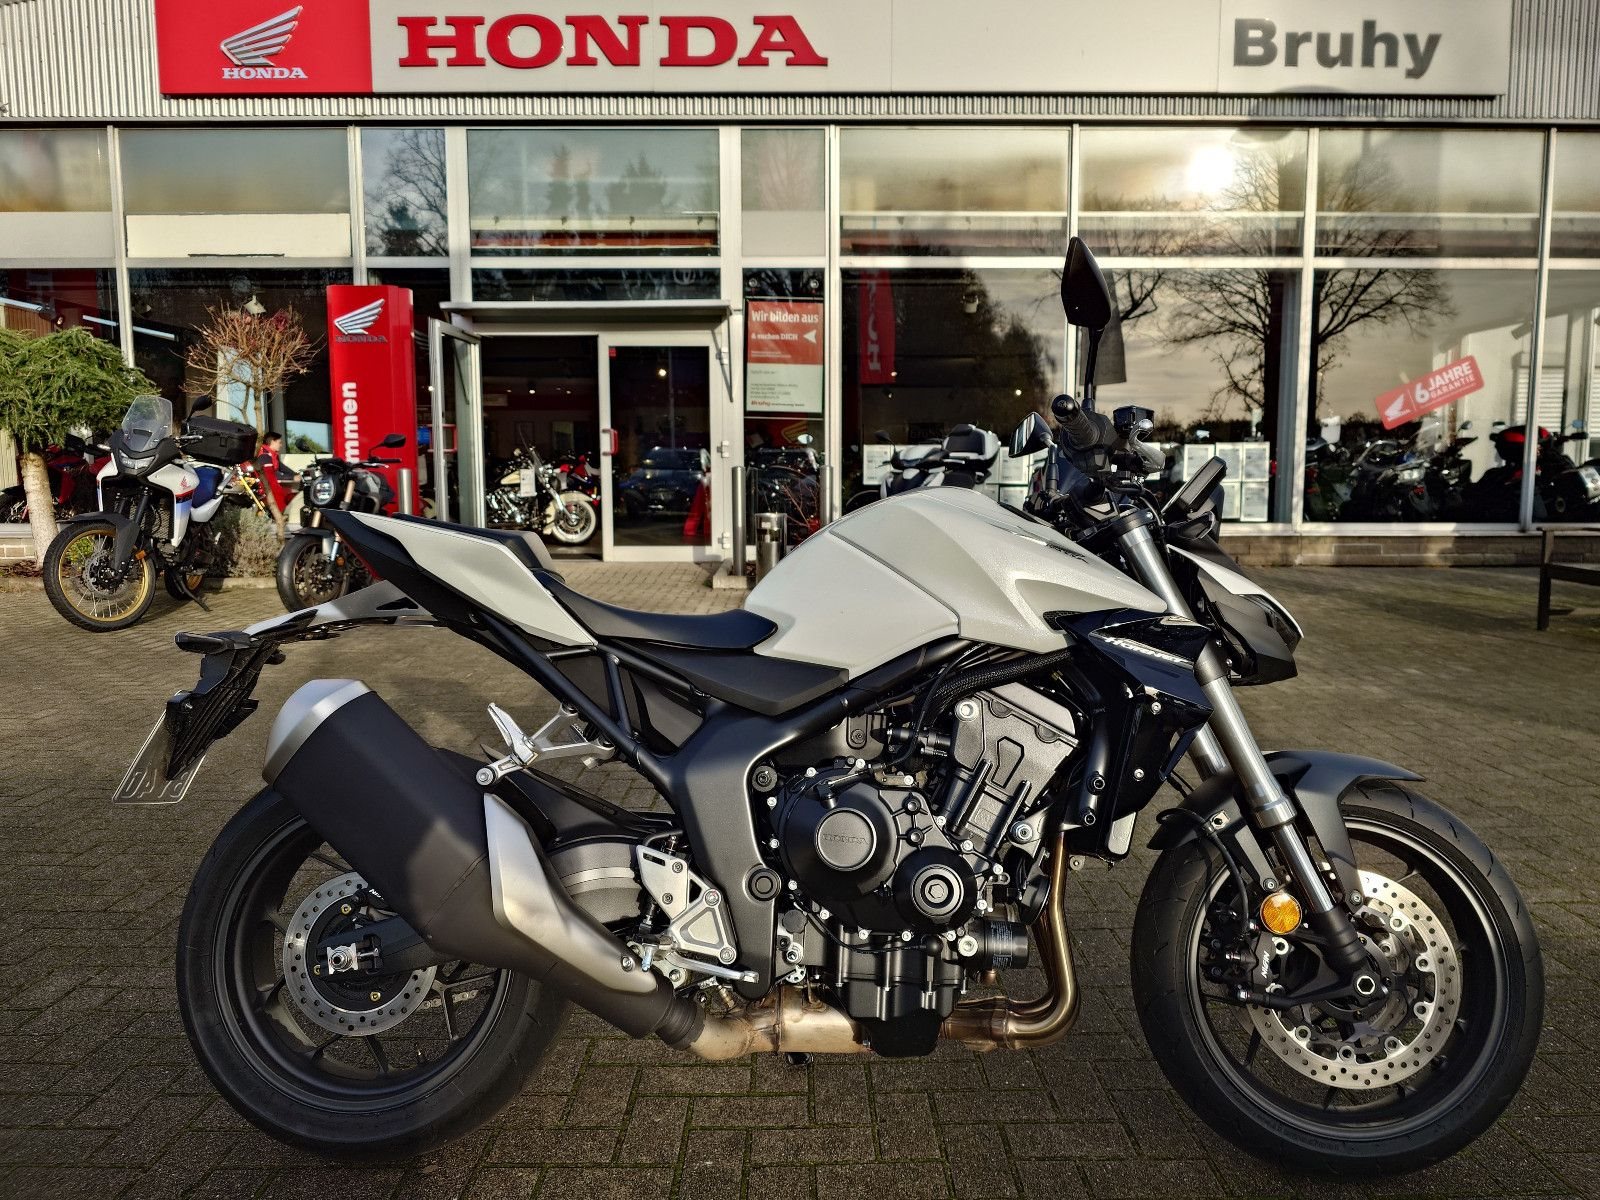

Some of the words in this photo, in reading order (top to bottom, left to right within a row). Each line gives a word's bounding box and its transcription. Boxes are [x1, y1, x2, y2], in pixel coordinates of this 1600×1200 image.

[397, 13, 829, 69] HONDA
[1233, 18, 1442, 79] Bruhy
[222, 67, 308, 79] HONDA
[751, 310, 769, 322] Wir
[770, 311, 800, 323] bilden
[801, 313, 819, 323] aus
[336, 335, 388, 343] HONDA
[781, 333, 798, 341] DICH
[1415, 382, 1430, 404] 6
[1428, 361, 1473, 391] JAHRE
[1430, 374, 1476, 399] GARANTIE
